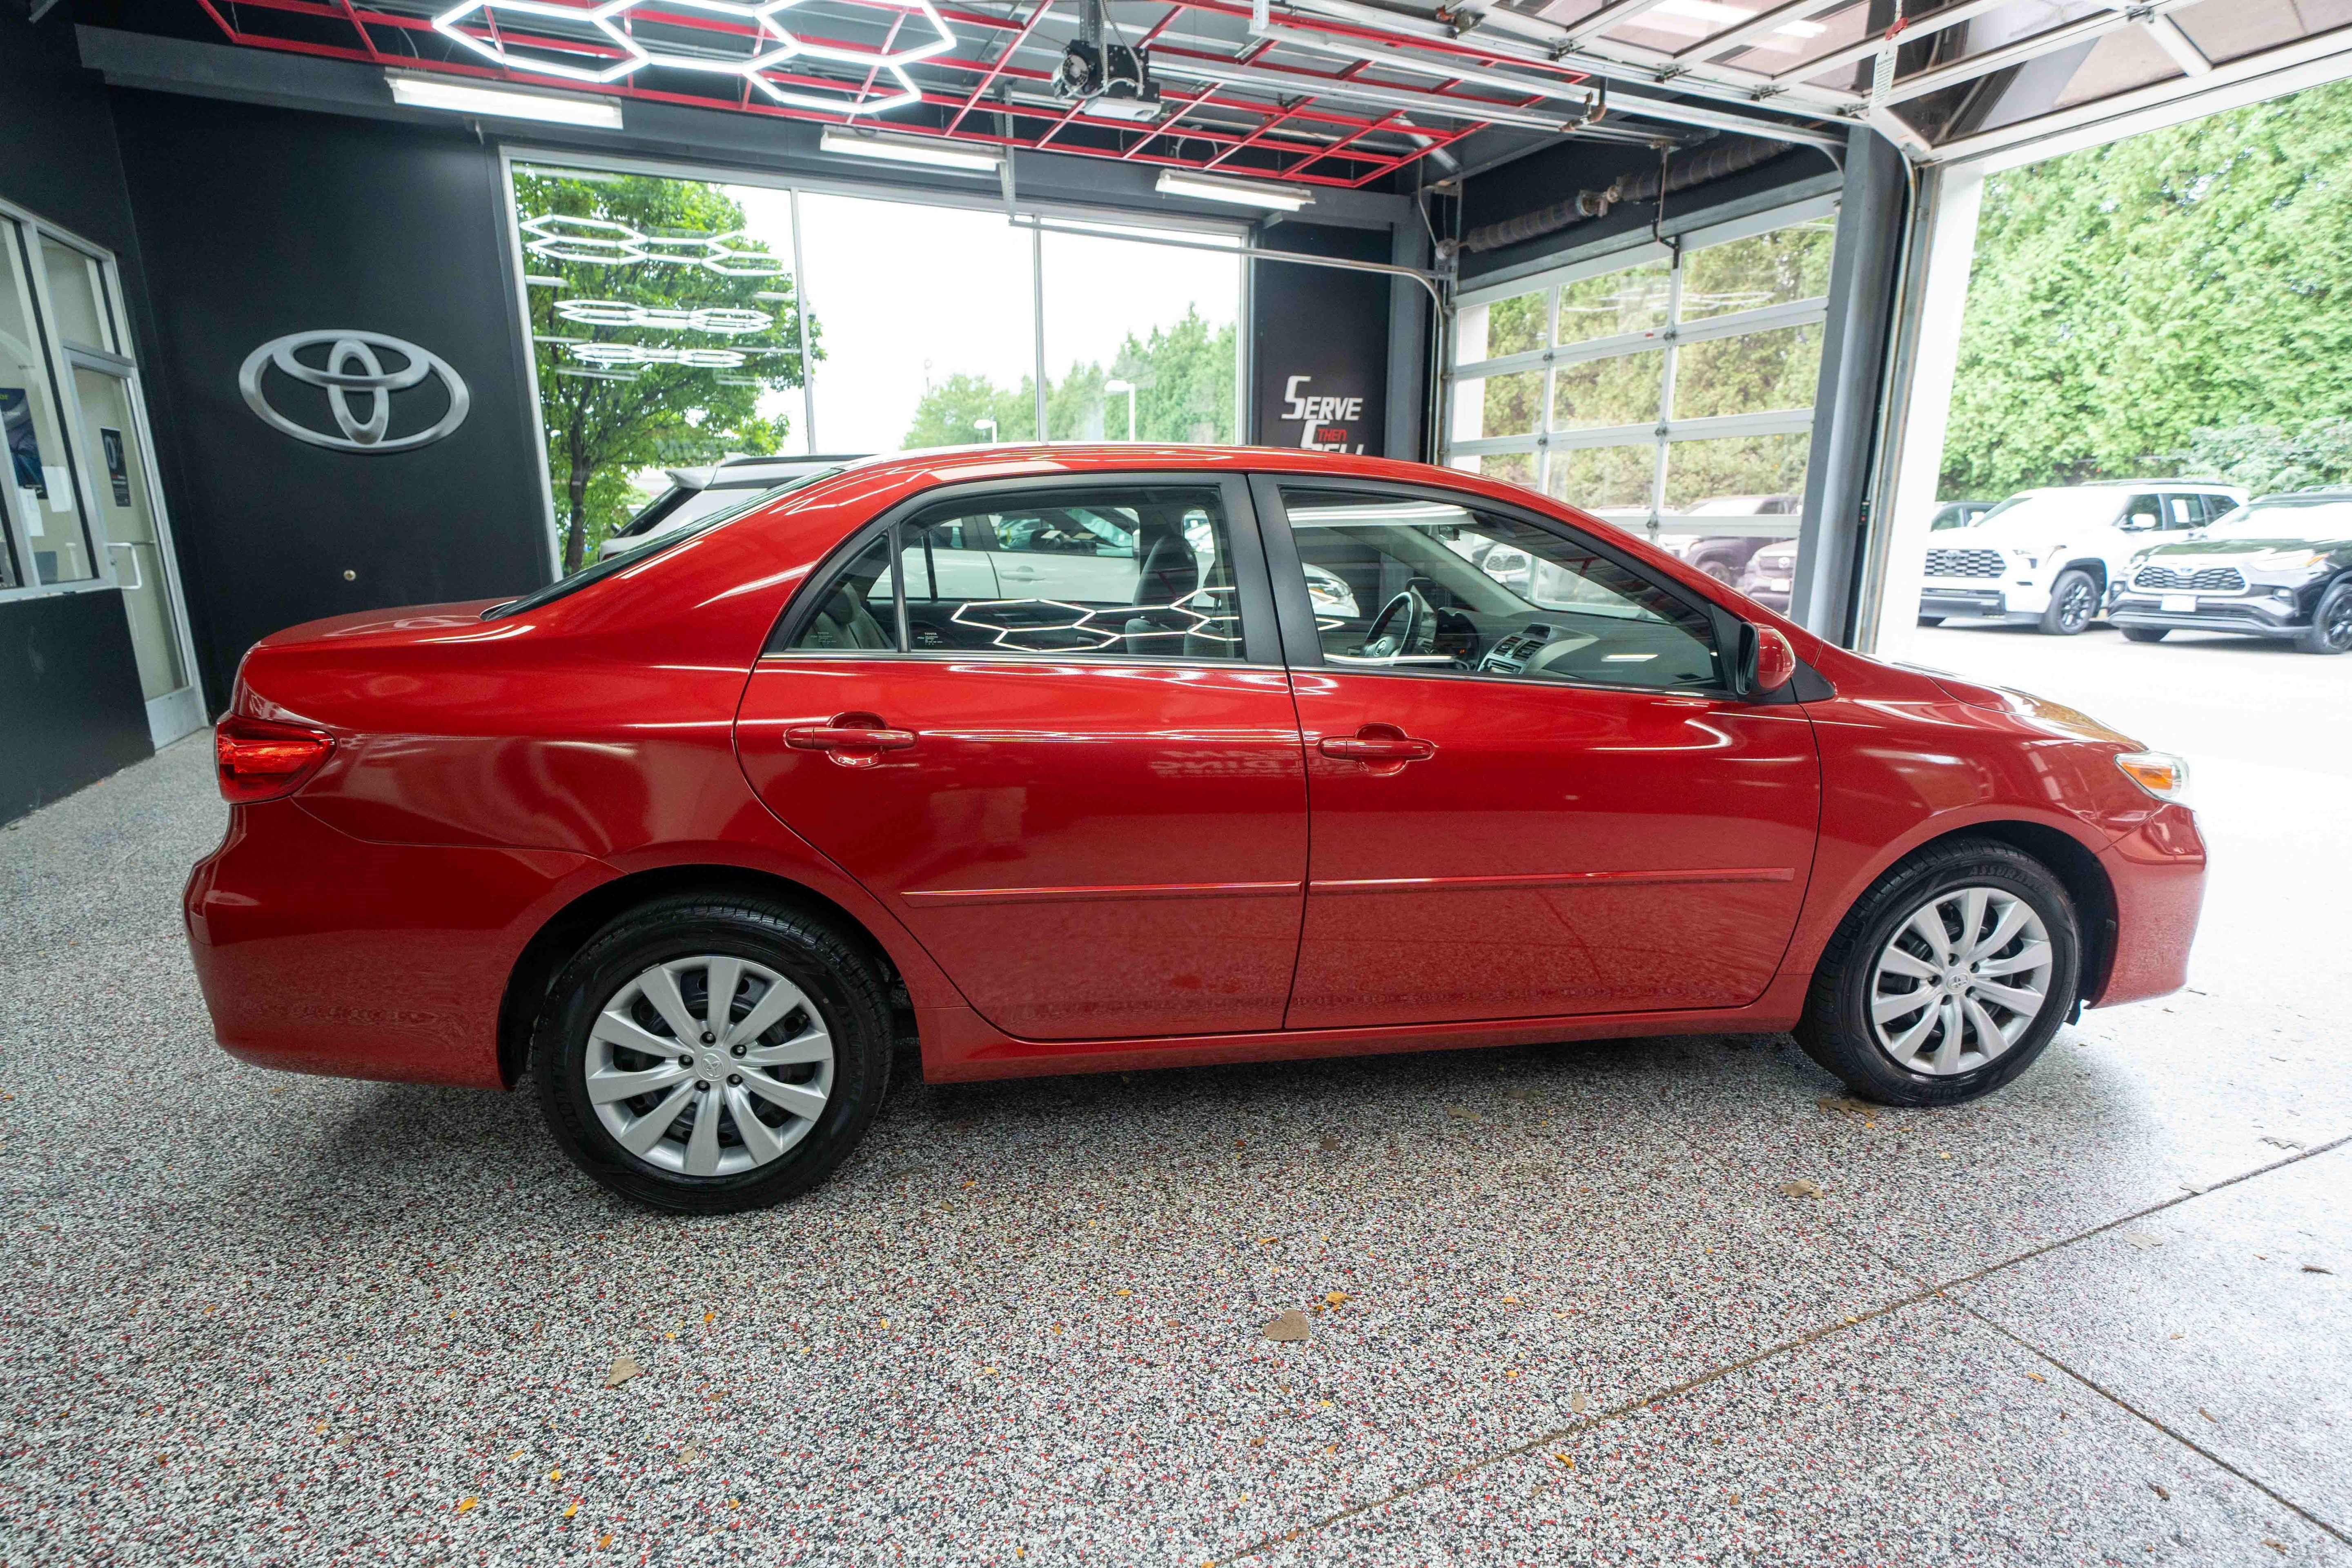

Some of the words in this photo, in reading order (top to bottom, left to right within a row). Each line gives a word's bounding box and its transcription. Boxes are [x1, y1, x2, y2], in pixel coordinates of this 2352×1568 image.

[1281, 375, 1363, 421] SERVE
[1317, 428, 1347, 441] THEN
[1968, 864, 2046, 895] ASSURAN
